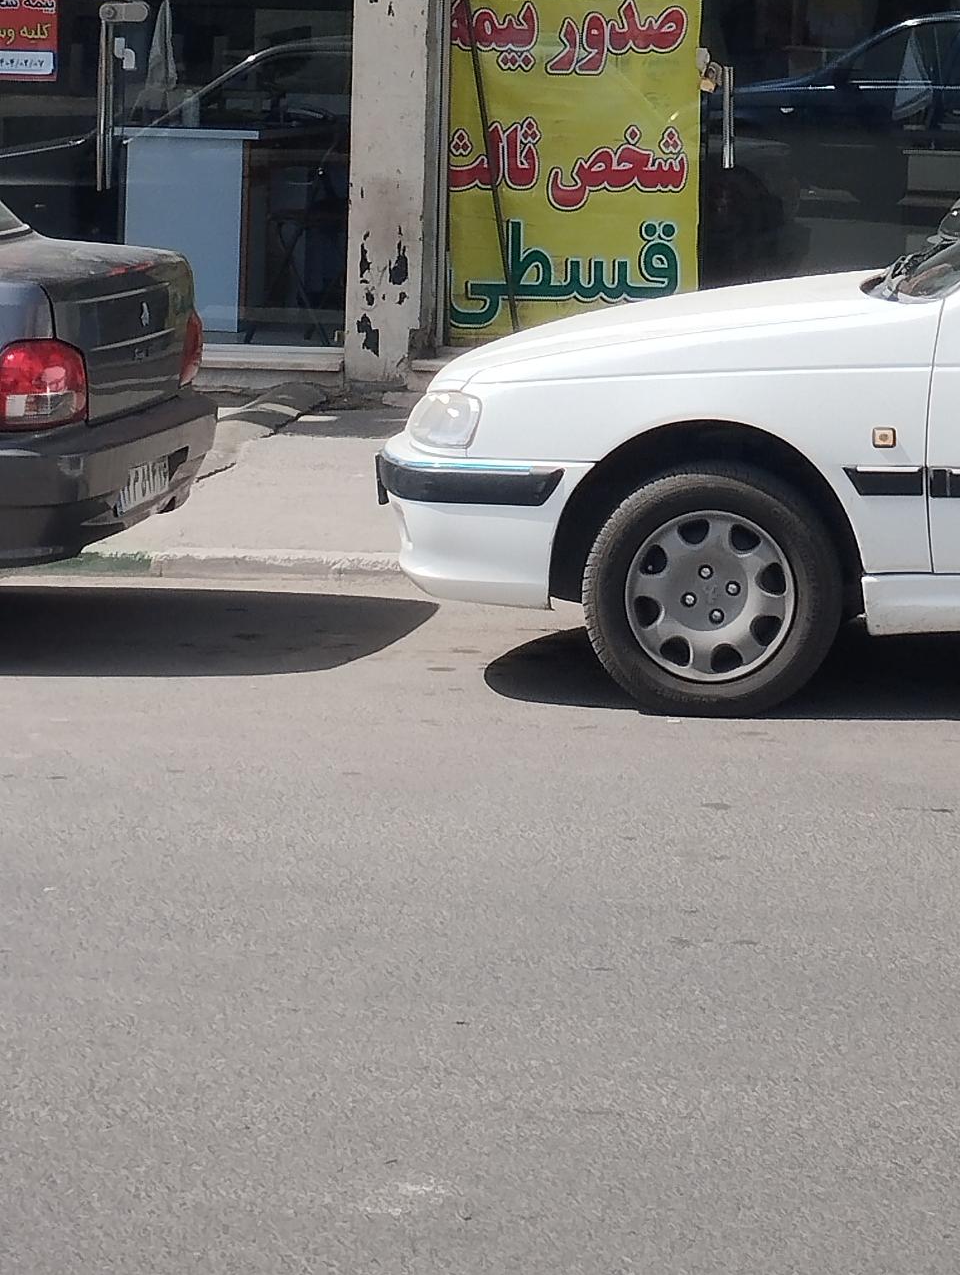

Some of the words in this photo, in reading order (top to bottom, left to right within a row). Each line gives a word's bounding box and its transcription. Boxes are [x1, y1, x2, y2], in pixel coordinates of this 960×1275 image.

[20, 23, 52, 44] کلیه
[450, 115, 540, 191] ثالث
[547, 124, 690, 213] شخص
[450, 219, 680, 325] قسطی
